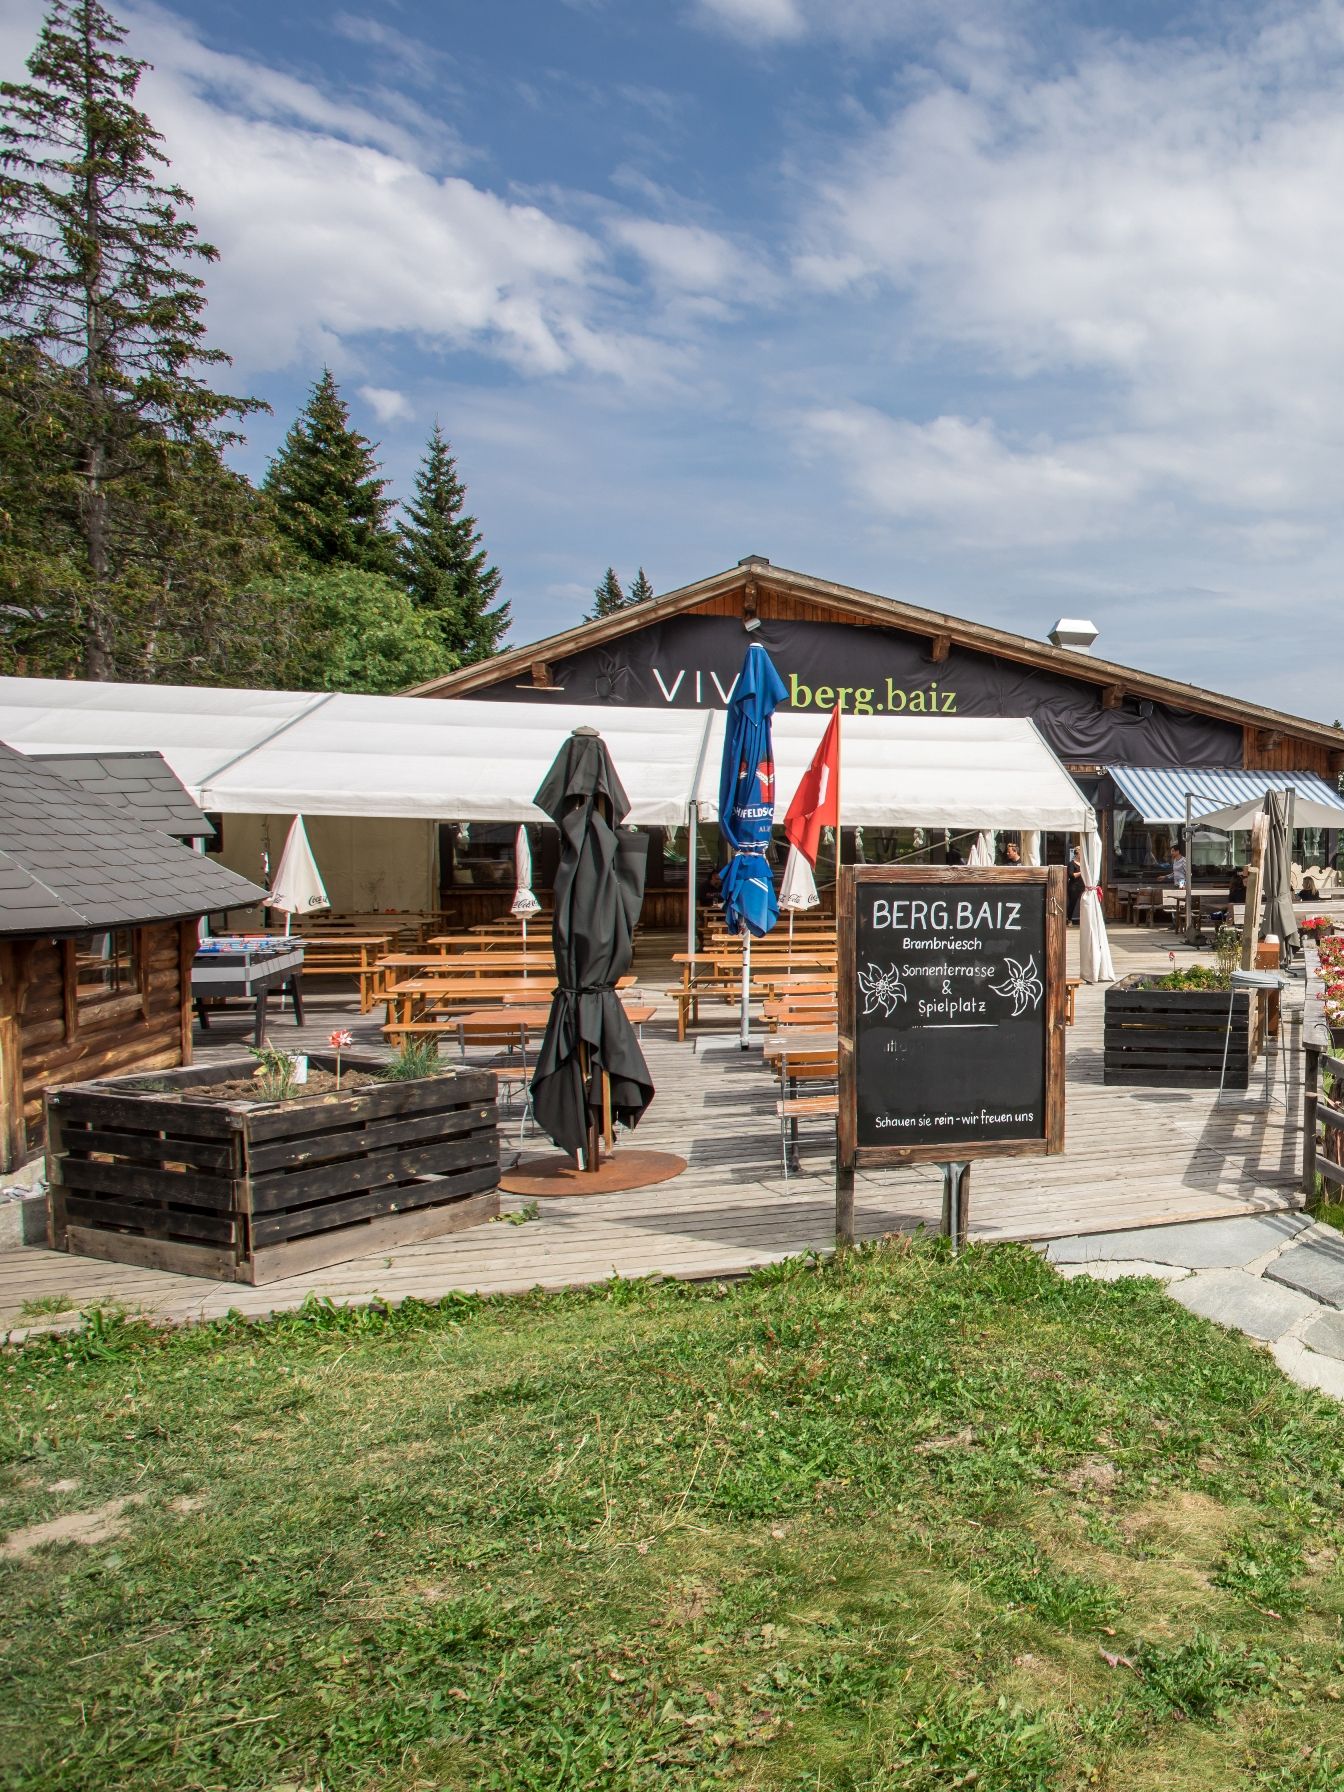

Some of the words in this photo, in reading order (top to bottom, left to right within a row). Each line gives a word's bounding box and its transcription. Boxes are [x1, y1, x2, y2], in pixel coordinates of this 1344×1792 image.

[652, 668, 742, 704] VIV
[788, 673, 958, 716] berg.baiz
[872, 899, 1022, 930] BERG.BAIZ
[902, 935, 982, 950] Brambrüesch
[901, 962, 995, 977] Sonnenterrasse
[941, 979, 952, 995] &
[918, 997, 987, 1019] Spielplatz
[875, 1115, 916, 1128] Schauen
[918, 1114, 932, 1127] sie
[980, 1109, 1013, 1124] freuen
[1014, 1111, 1034, 1122] uns
